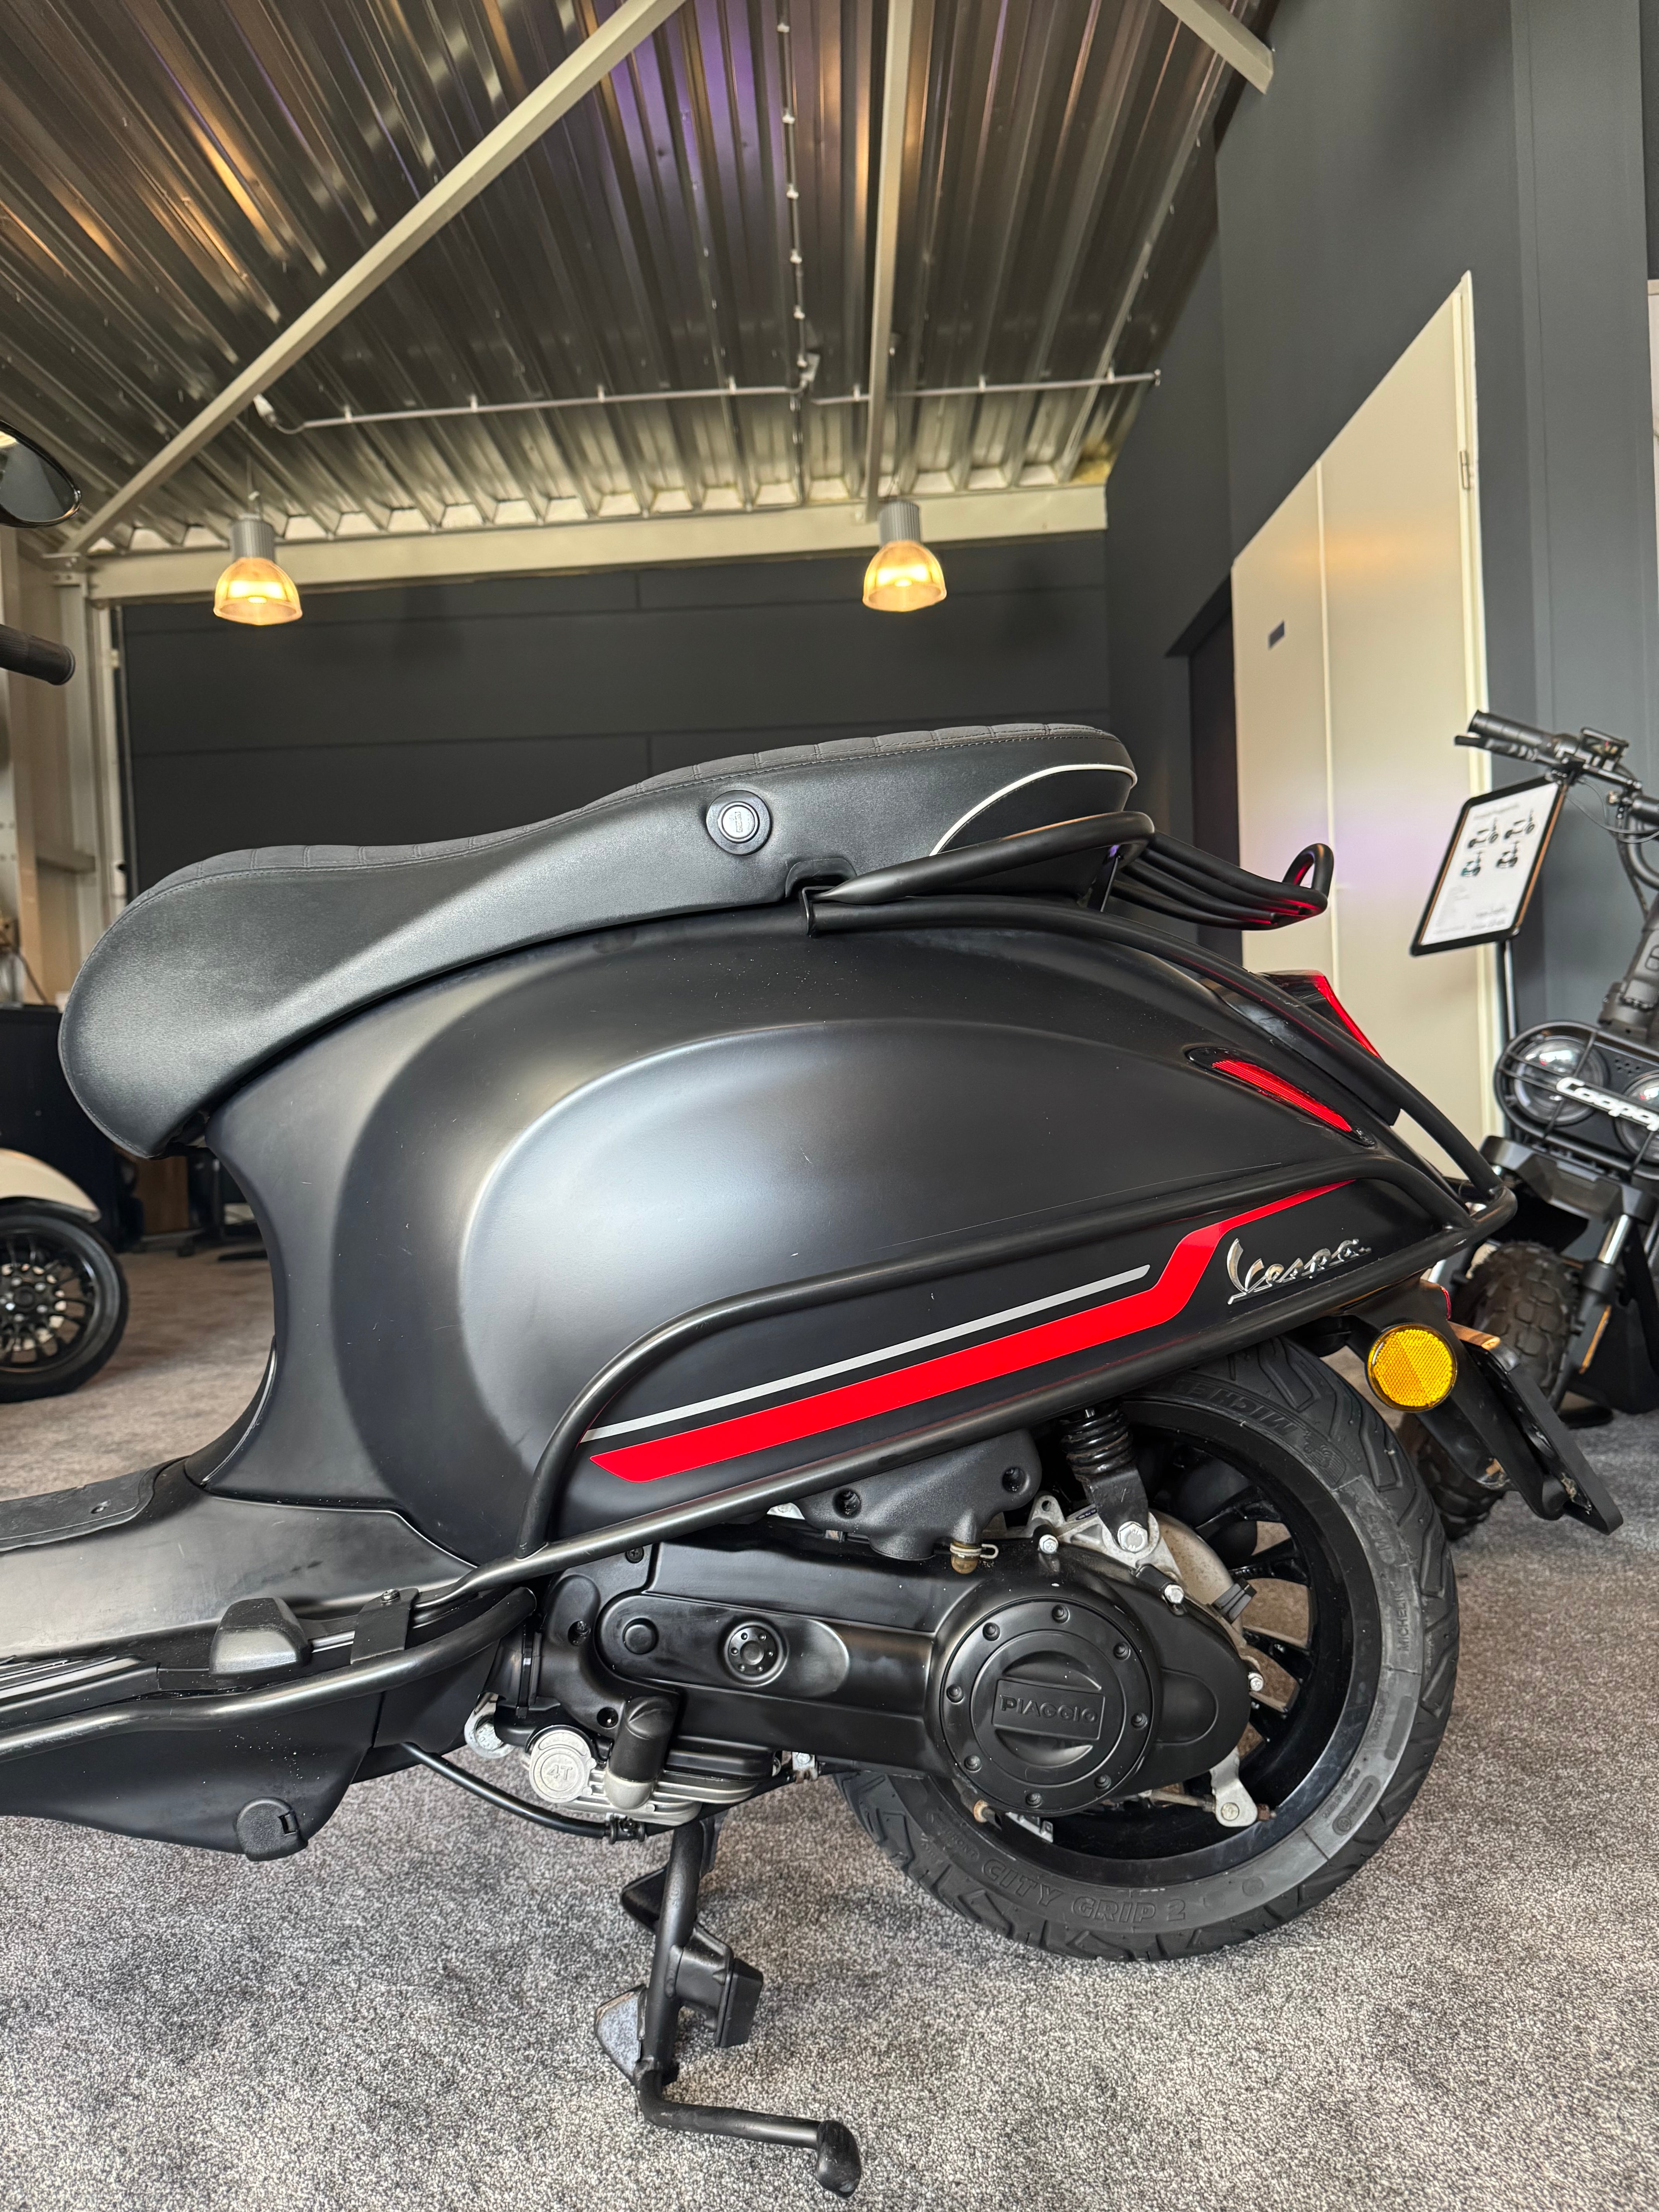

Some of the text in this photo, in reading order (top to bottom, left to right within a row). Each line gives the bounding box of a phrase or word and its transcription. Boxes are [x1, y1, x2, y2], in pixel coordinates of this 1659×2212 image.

[1227, 1238, 1372, 1305] Vespa
[1175, 1379, 1299, 1436] MICHE
[1395, 1587, 1409, 1652] MICHELIN
[1000, 1695, 1097, 1722] PIAGGIO
[546, 1764, 573, 1780] 4T
[981, 1859, 1186, 1923] CITY GRIP 2
